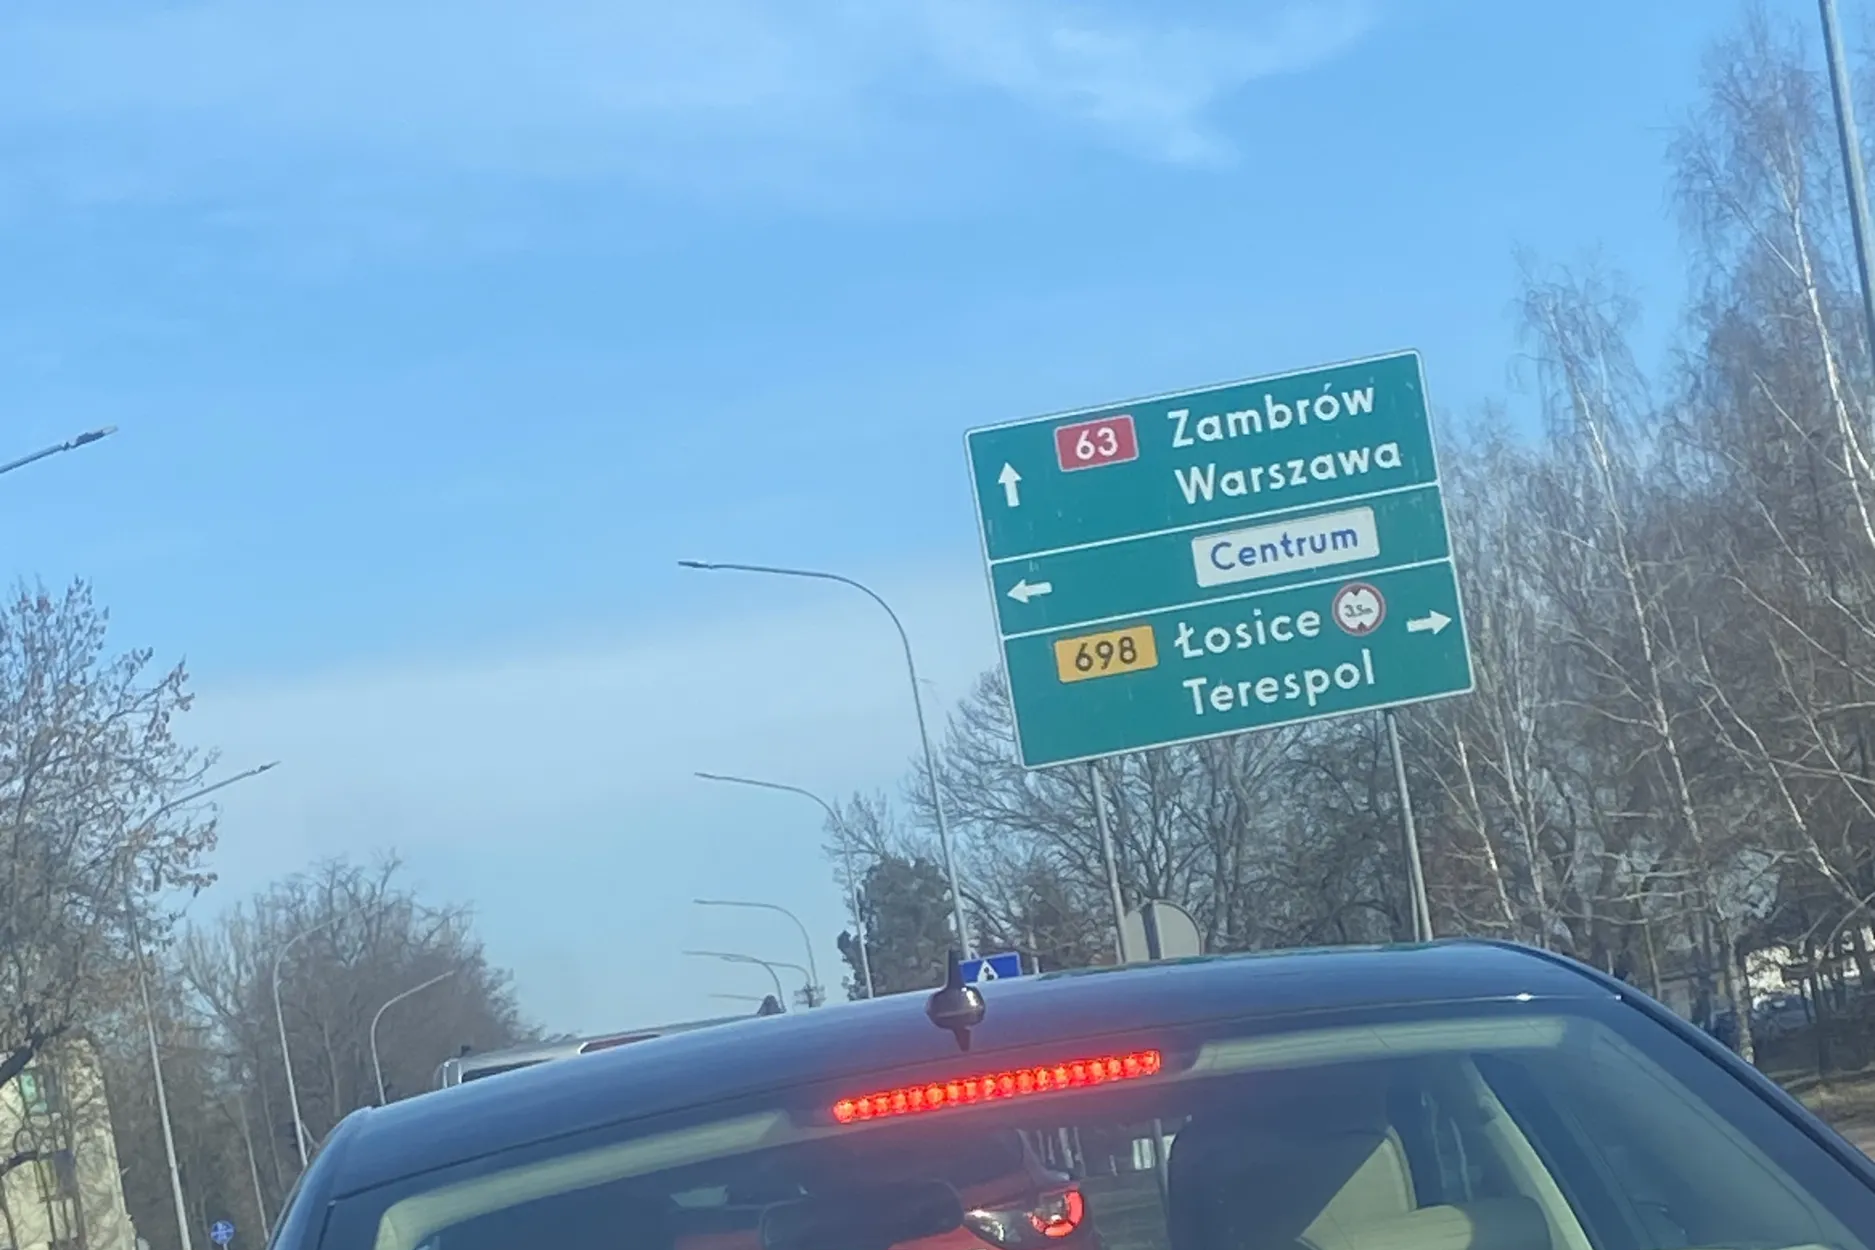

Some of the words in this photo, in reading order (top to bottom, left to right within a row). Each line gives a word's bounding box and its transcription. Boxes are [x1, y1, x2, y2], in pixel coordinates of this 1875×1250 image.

[1167, 383, 1374, 448] Zambrów
[1075, 427, 1118, 460] 63
[1174, 442, 1402, 504] Warszawa
[1211, 529, 1358, 570] Centrum
[1075, 636, 1137, 671] 698
[1174, 608, 1321, 658] Łosice
[1183, 649, 1375, 715] Terespol
